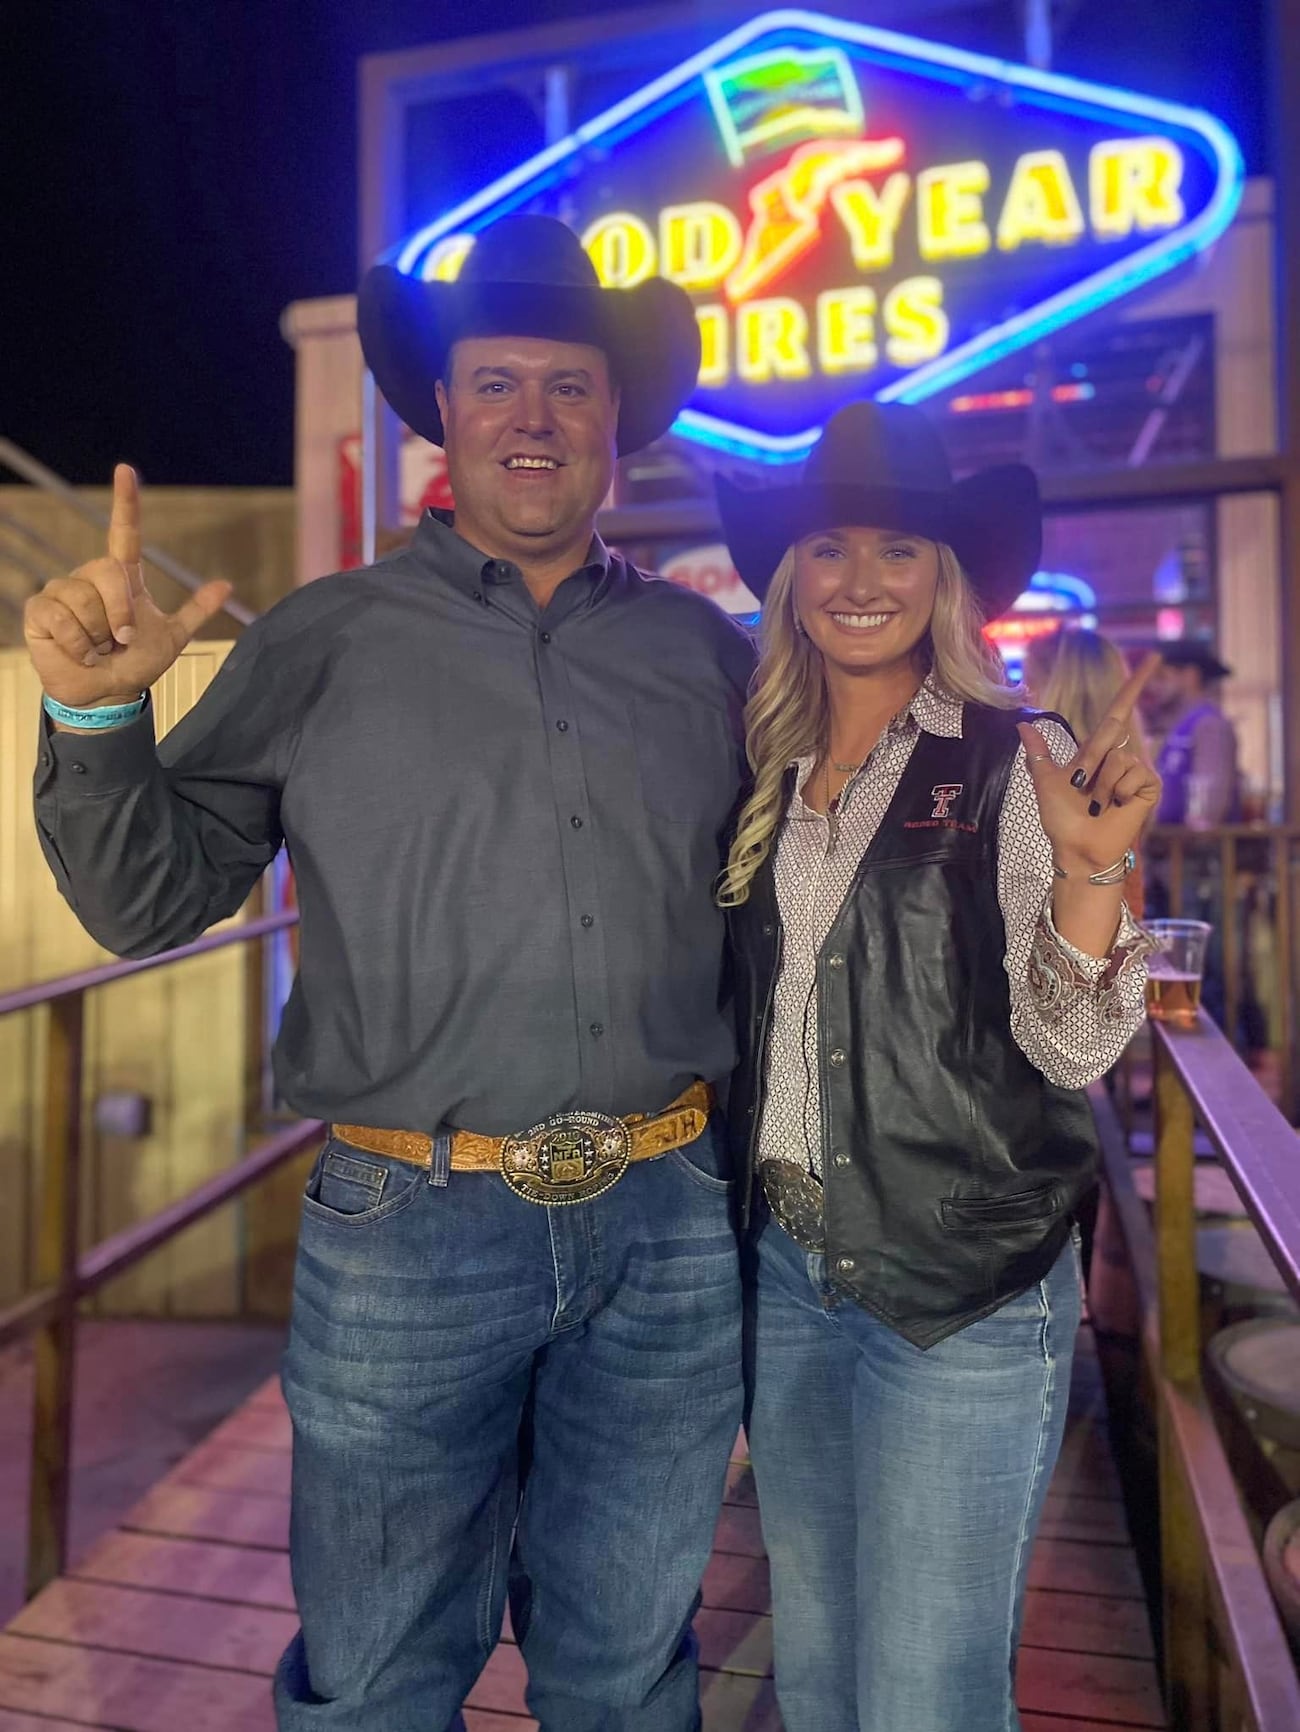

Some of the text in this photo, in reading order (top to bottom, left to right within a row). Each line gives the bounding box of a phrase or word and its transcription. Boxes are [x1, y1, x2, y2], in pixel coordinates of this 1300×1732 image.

[830, 136, 1185, 272] YEAR
[695, 276, 949, 388] IRES
[943, 818, 977, 833] TEAM
[549, 1115, 600, 1127] GO-ROUND
[553, 1149, 581, 1161] NFR
[521, 1183, 575, 1201] TIE-DOWN
